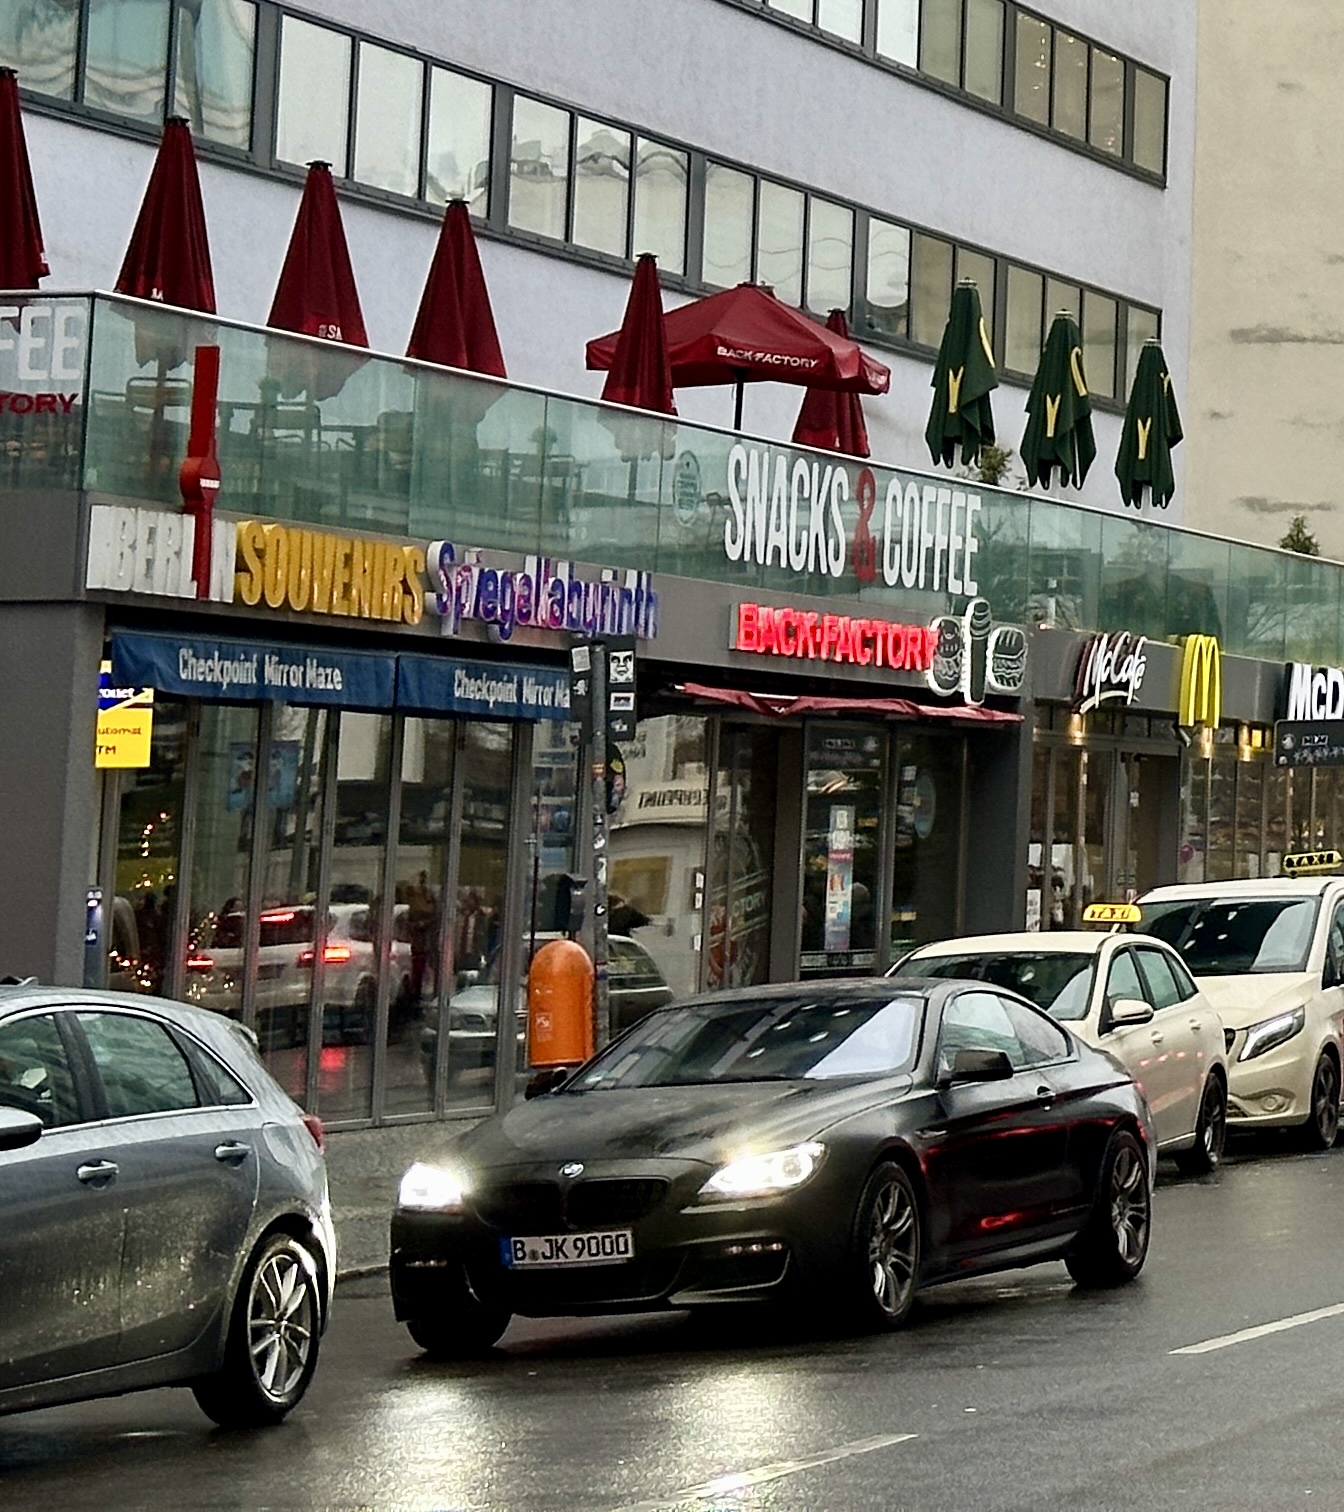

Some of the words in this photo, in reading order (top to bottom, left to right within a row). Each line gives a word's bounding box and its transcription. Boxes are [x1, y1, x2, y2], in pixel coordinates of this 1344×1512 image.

[725, 444, 848, 579] SNACKS
[852, 466, 877, 584] &
[882, 476, 982, 597] COFFEE
[236, 520, 425, 626] SOUVENIRS
[178, 647, 257, 690] Checkpoint
[264, 654, 305, 688] Mirror
[306, 658, 343, 692] Maze
[454, 669, 519, 709] Checkpoint
[522, 675, 555, 707] Mirror
[1291, 853, 1326, 867] TAXI
[1090, 907, 1129, 920] TAXI
[513, 1240, 526, 1261] B
[541, 1238, 569, 1260] JK
[573, 1234, 628, 1258] 9000
